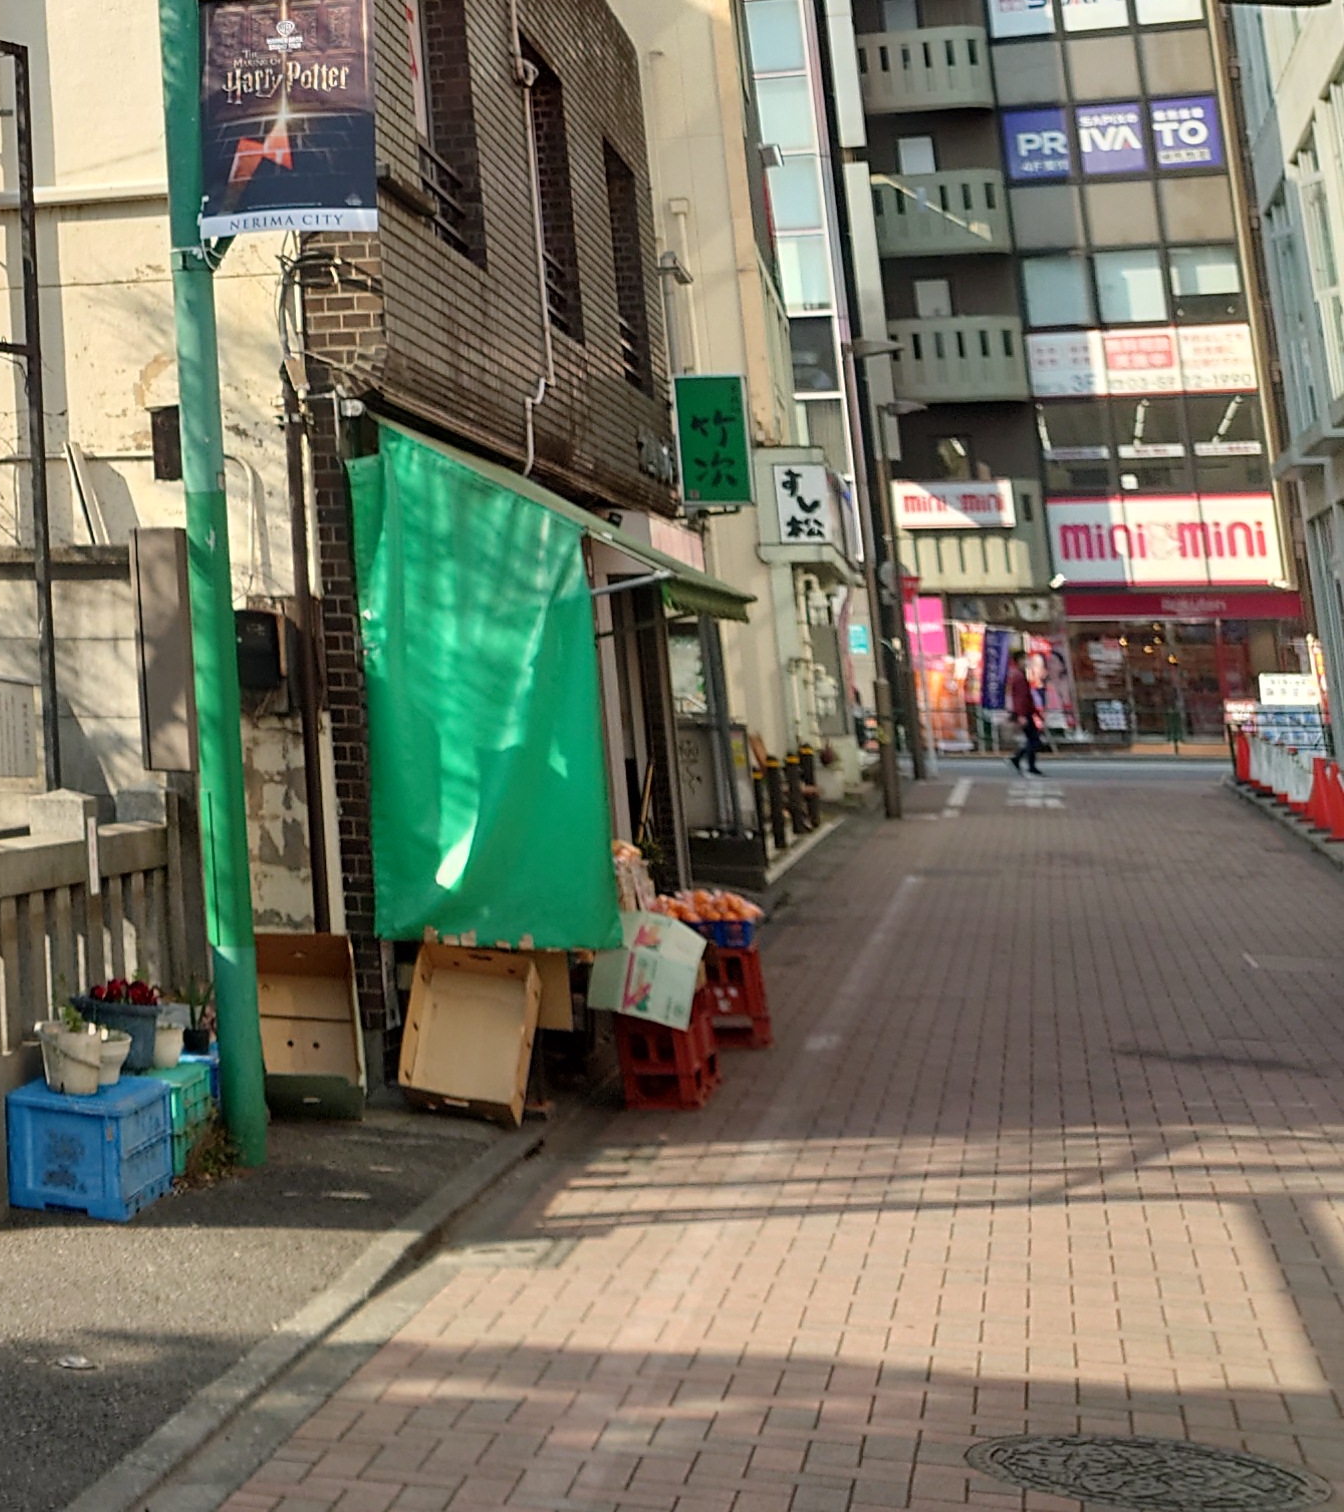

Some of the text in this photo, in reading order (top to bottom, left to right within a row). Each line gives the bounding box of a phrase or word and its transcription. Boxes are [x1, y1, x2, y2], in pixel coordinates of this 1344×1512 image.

[222, 61, 350, 105] Harry Potter
[1016, 119, 1209, 157] PRIVATO
[229, 214, 344, 231] NERIMA CITY
[781, 468, 826, 538] すし松
[903, 494, 1005, 513] mini mini
[1059, 520, 1267, 561] mini mini
